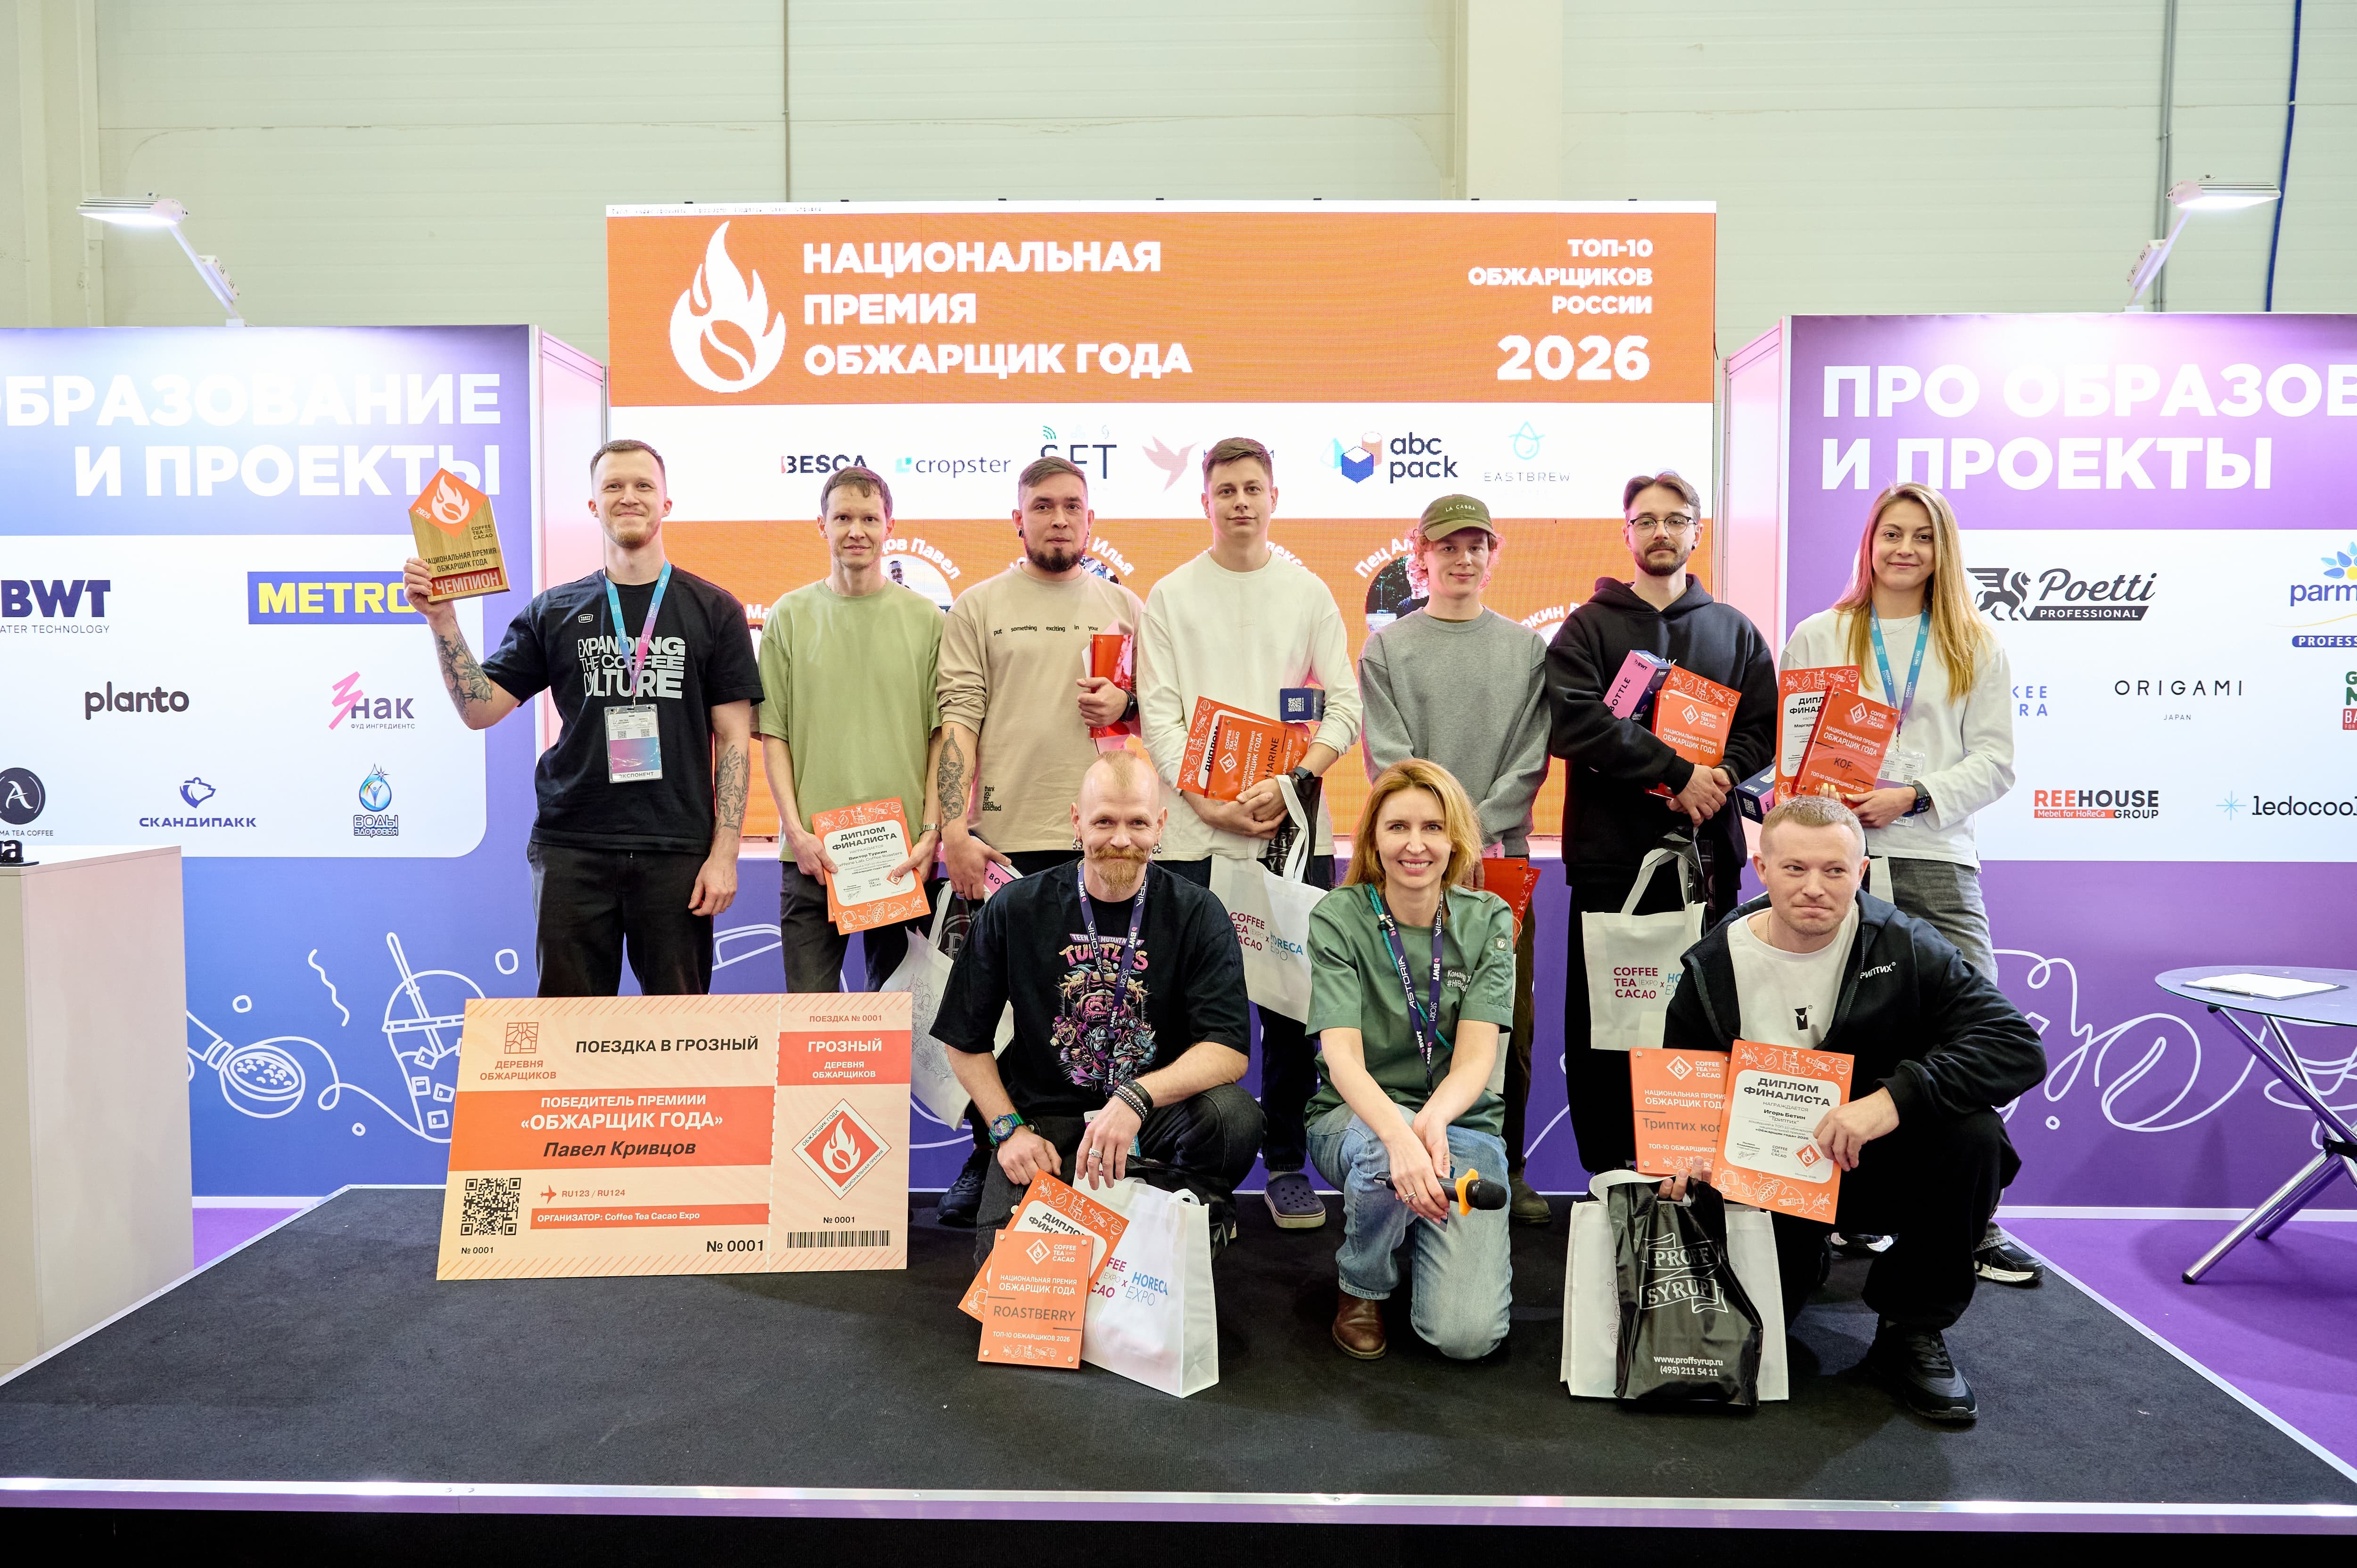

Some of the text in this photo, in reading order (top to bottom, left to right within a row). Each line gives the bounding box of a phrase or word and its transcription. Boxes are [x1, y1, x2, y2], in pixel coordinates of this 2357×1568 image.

[1567, 238, 1654, 256] ТОП-10
[803, 241, 1161, 278] НАЦИОНАЛЬНАЯ
[1468, 267, 1653, 288] ОБЖАРЩИКОВ
[804, 294, 976, 325] ПРЕМИЯ
[1552, 296, 1652, 314] РОССИИ
[804, 343, 1193, 379] ОБЖАРЩИК ГОДА
[1497, 335, 1650, 380] 2026
[0, 372, 501, 426] БРАЗОВАНИЕ
[1823, 364, 1980, 418] ПРО
[1390, 431, 1442, 456] abc
[74, 445, 500, 496] И ПРОЕКТЫ
[915, 457, 1011, 478] cropster
[1389, 456, 1459, 484] pack
[1822, 436, 2272, 491] И ПРОЕКТЫ
[1484, 472, 1571, 482] EASTBREW
[415, 507, 431, 519] 2026
[472, 548, 496, 557] ПРЕМИЯ
[911, 538, 961, 580] Павел
[1092, 537, 1135, 577] Илья
[437, 558, 487, 572] ОБЖАРЩИК ГОДА
[1354, 547, 1392, 578] Пец
[435, 571, 500, 594] ЧЕМПИОН
[2039, 568, 2157, 601] Poetti
[0, 580, 111, 617] BWT
[258, 582, 418, 613] METRO
[2040, 609, 2139, 618] PROFESSIONAL
[32, 625, 110, 633] TECHNOLOGY
[994, 628, 1002, 636] put
[579, 655, 599, 673] THE
[1637, 661, 1648, 671] BWT
[2114, 680, 2242, 696] ORIGAMI
[85, 681, 190, 720] planto
[1701, 711, 1717, 720] COFFEE
[1871, 710, 1887, 720] COFFEE
[1700, 721, 1716, 729] CACAO
[1867, 720, 1883, 729] CACAO
[1248, 731, 1256, 753] ПРЕМИЯ
[1254, 732, 1263, 752] ГОДА
[1663, 734, 1716, 755] ОБЖАРЩИК ГОДА
[1664, 727, 1717, 747] НАЦИОНАЛЬНАЯ ПРЕМИЯ
[1824, 732, 1877, 756] ОБЖАРЩИК ГОДА
[1826, 725, 1880, 748] НАЦИОНАЛЬНАЯ ПРЕМИЯ
[1834, 757, 1853, 771] KOF.
[2034, 790, 2159, 807] REEHOUSE
[139, 818, 257, 827] СКАНДИПАКК
[2113, 810, 2159, 818] GROUP
[832, 833, 897, 850] ФИНАЛИСТА
[841, 826, 885, 841] ДИПЛОМ
[1230, 911, 1265, 930] COFFEE
[1128, 932, 1137, 949] BWT
[1119, 968, 1129, 988] STORM
[1433, 963, 1441, 981] BWT
[1614, 967, 1658, 977] COFFEE
[1398, 955, 1417, 1010] ASTORIA
[1614, 978, 1636, 987] TEA
[1615, 989, 1656, 999] CACAO
[1110, 1010, 1118, 1027] BWT
[1429, 1002, 1437, 1022] STORM
[576, 1036, 759, 1055] ПОЕЗДКА В ГРОЗНЫЙ
[808, 1038, 882, 1052] ГРОЗНЫЙ
[1417, 1030, 1425, 1049] BWT
[494, 1060, 544, 1069] ДЕРЕВНЯ
[824, 1061, 865, 1069] ДЕРЕВНЯ
[479, 1071, 557, 1081] ОБЖАРЩИКОВ
[812, 1071, 876, 1079] ОБЖАРЩИКОВ
[1645, 1090, 1699, 1098] НАЦИОНАЛЬНАЯ
[1758, 1078, 1819, 1093] ДИПЛОМ
[541, 1094, 707, 1109] ПОБЕДИТЕЛЬ ПРЕМИИИ
[1645, 1097, 1701, 1108] ОБЖАРЩИК
[1744, 1087, 1830, 1107] ФИНАЛИСТА
[1763, 1101, 1808, 1112] НАГРАЖДАЕТСЯ
[520, 1112, 723, 1131] «ОБЖАРЩИК ГОДА»
[801, 1109, 840, 1147] ОБЖАРЩИК ГОДА
[1643, 1118, 1697, 1131] Триптих
[544, 1141, 696, 1159] Павел Кривцов
[1671, 1145, 1716, 1153] ОБЖАРЩИКОВ
[561, 1189, 625, 1198] RU123 RU124
[537, 1214, 603, 1222] ОРГАНИЗАТОР:
[605, 1213, 633, 1221] Coffee
[652, 1212, 677, 1220] Cacao
[679, 1211, 700, 1222] Expo
[707, 1240, 764, 1252] № 0001
[1000, 1274, 1051, 1284] НАЦИОНАЛЬНАЯ
[1131, 1272, 1168, 1296] HORECA
[999, 1283, 1075, 1296] ОБЖАРЩИК ГОДА
[1125, 1286, 1155, 1305] EXPO
[1648, 1280, 1711, 1305] SYRUP
[994, 1305, 1076, 1322] ROASTBERRY
[1013, 1332, 1055, 1341] ОБЖАРЩИКОВ
[1654, 1355, 1723, 1367] www.proffsyrup.ru
[1660, 1366, 1719, 1377] (495) 211 54 11
